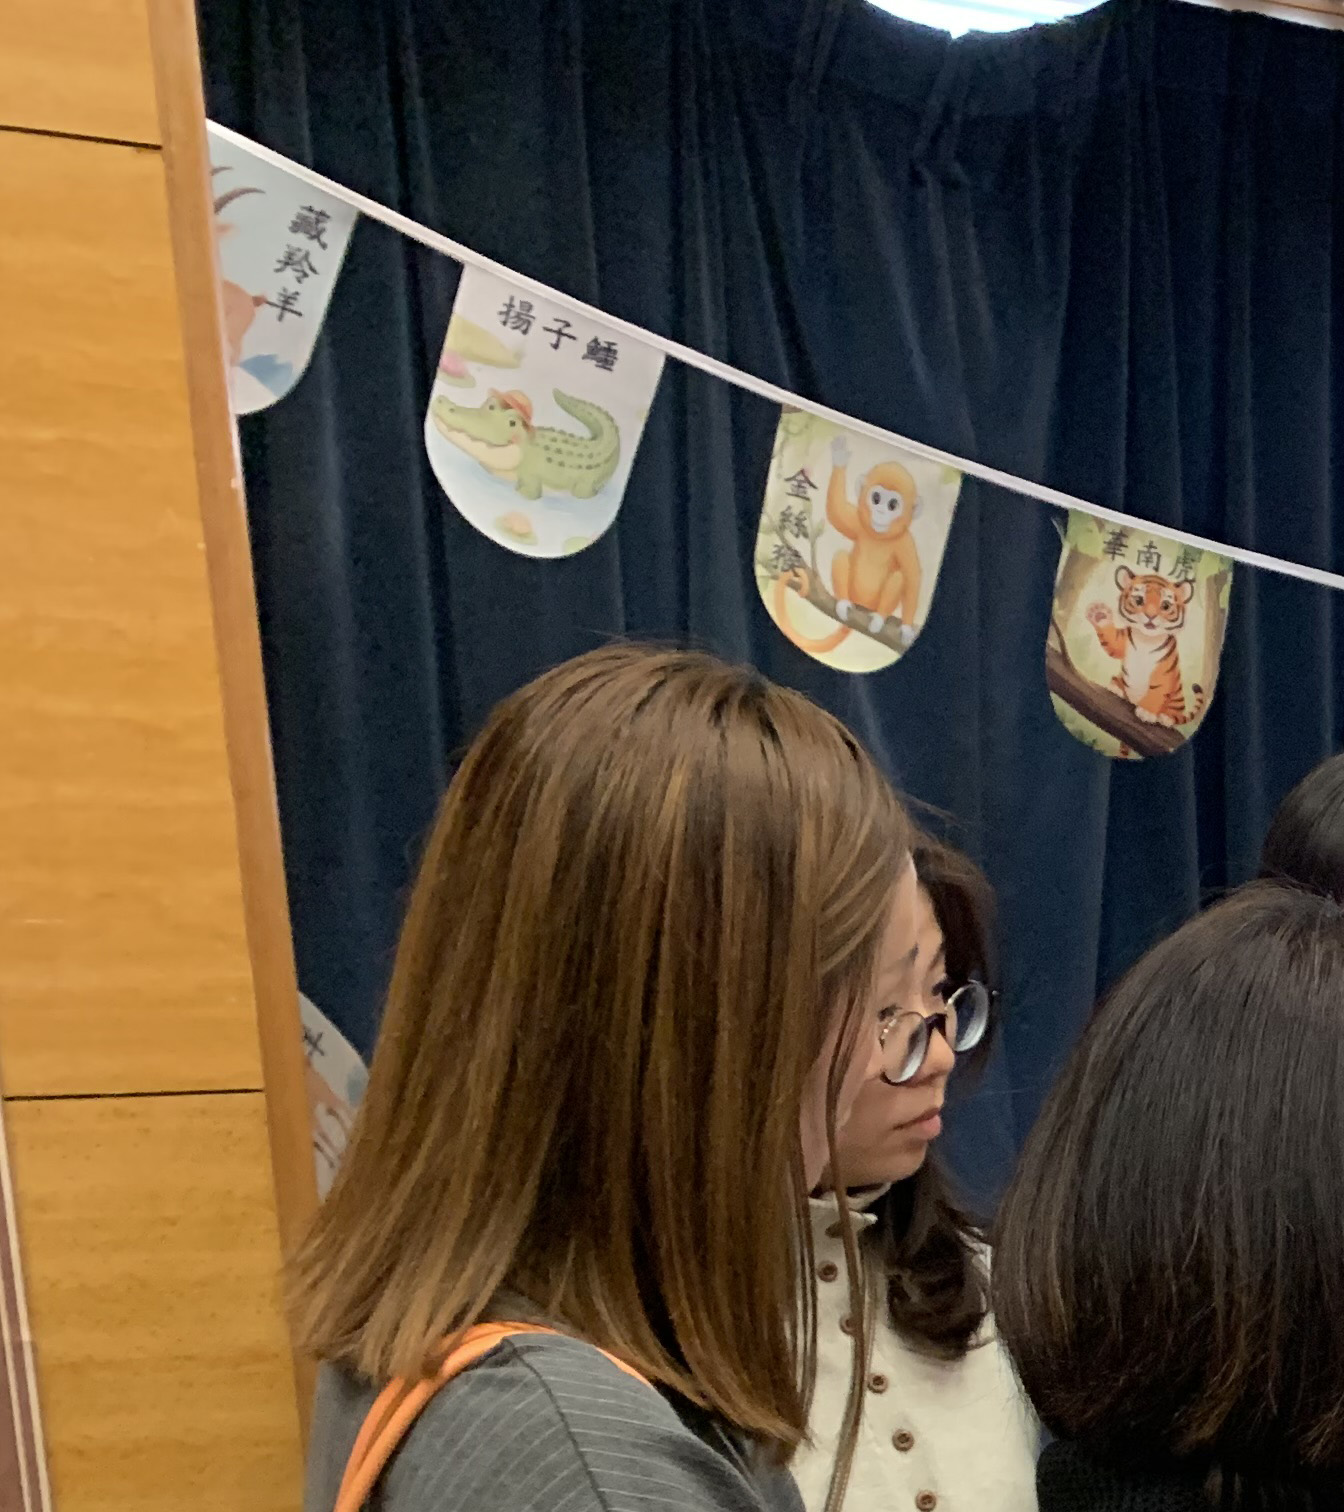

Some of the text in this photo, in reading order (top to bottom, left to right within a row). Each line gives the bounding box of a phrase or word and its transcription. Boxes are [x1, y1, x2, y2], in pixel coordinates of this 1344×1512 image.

[264, 204, 330, 324] 藏羚羊
[497, 295, 619, 372] 揚子鱷
[773, 468, 818, 577] 金絲猴
[1103, 529, 1196, 583] 華南虎
